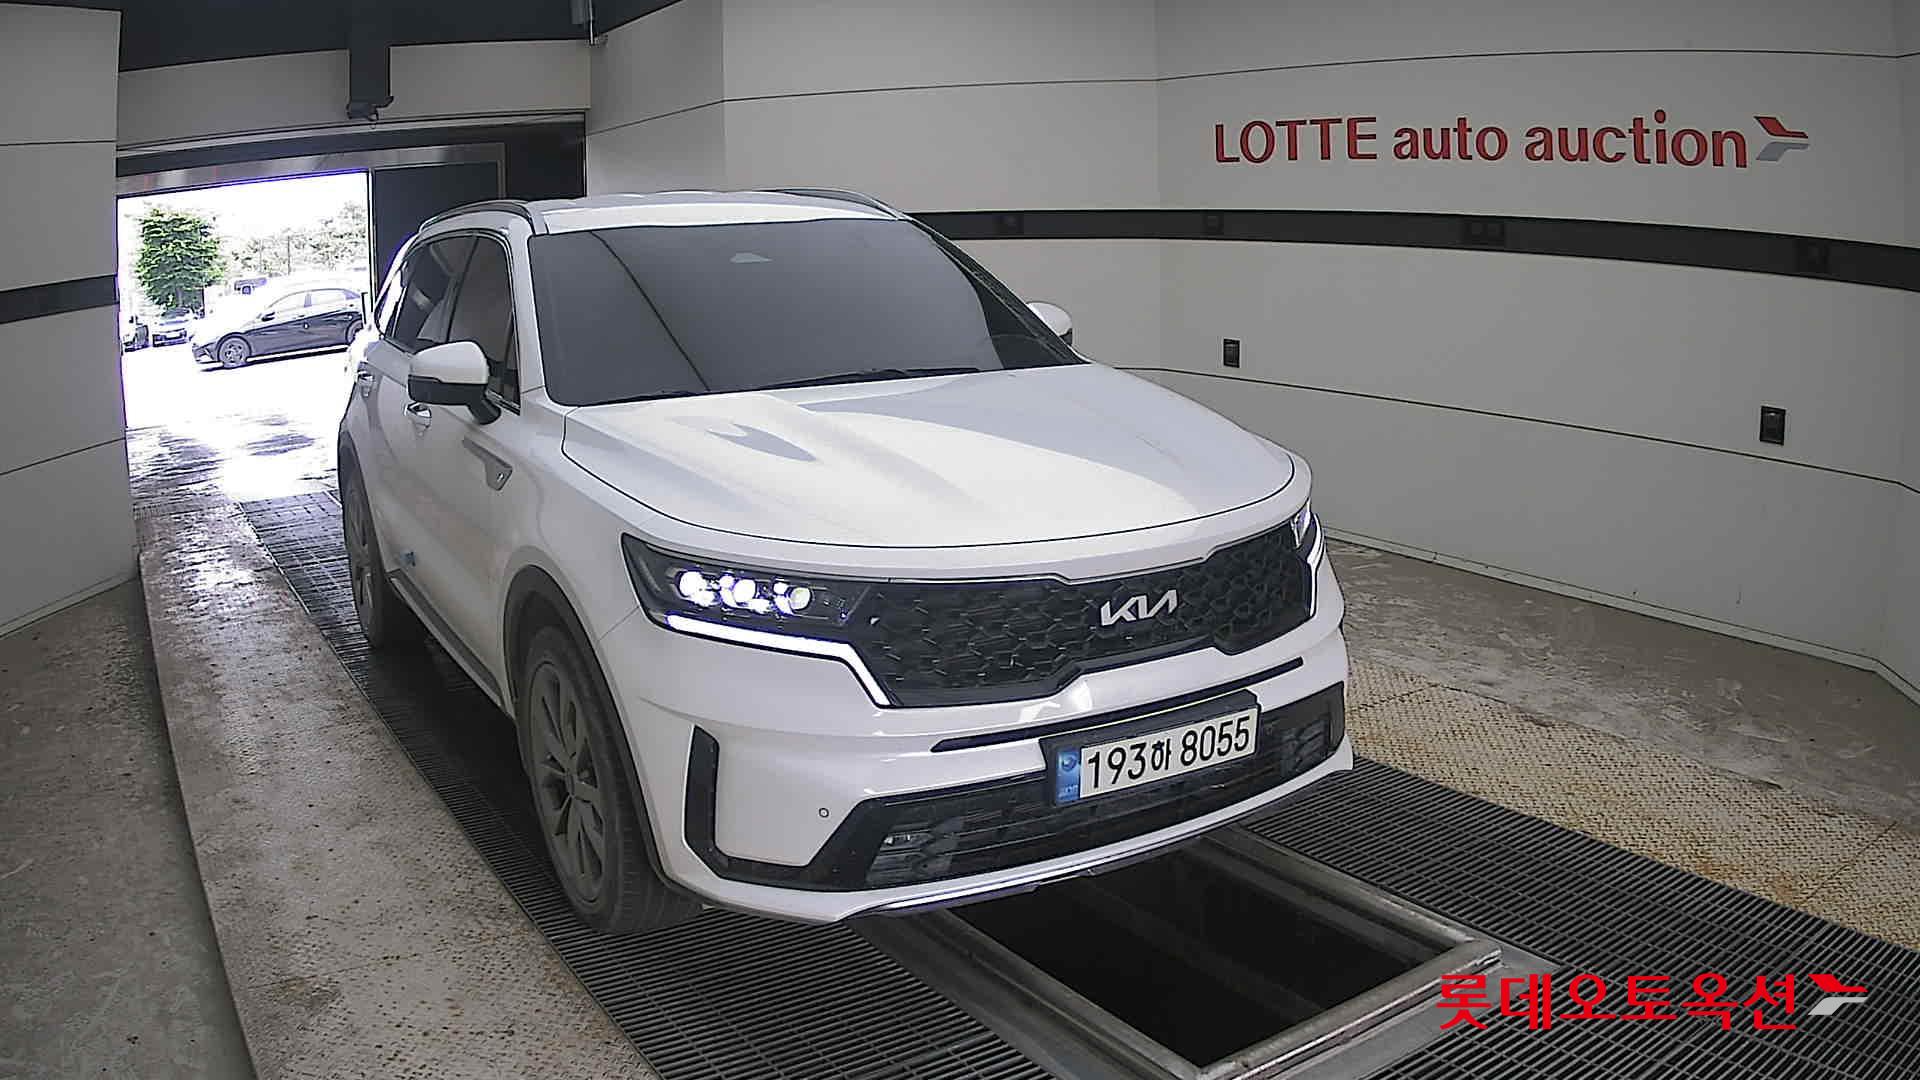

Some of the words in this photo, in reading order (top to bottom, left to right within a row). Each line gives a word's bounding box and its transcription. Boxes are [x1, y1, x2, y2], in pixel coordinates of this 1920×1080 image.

[1214, 116, 1378, 163] LOTTE
[1392, 116, 1509, 162] auto
[1523, 109, 1749, 169] auction
[1100, 589, 1178, 626] KIA
[1087, 738, 1172, 789] 193하
[1180, 715, 1251, 768] 8055
